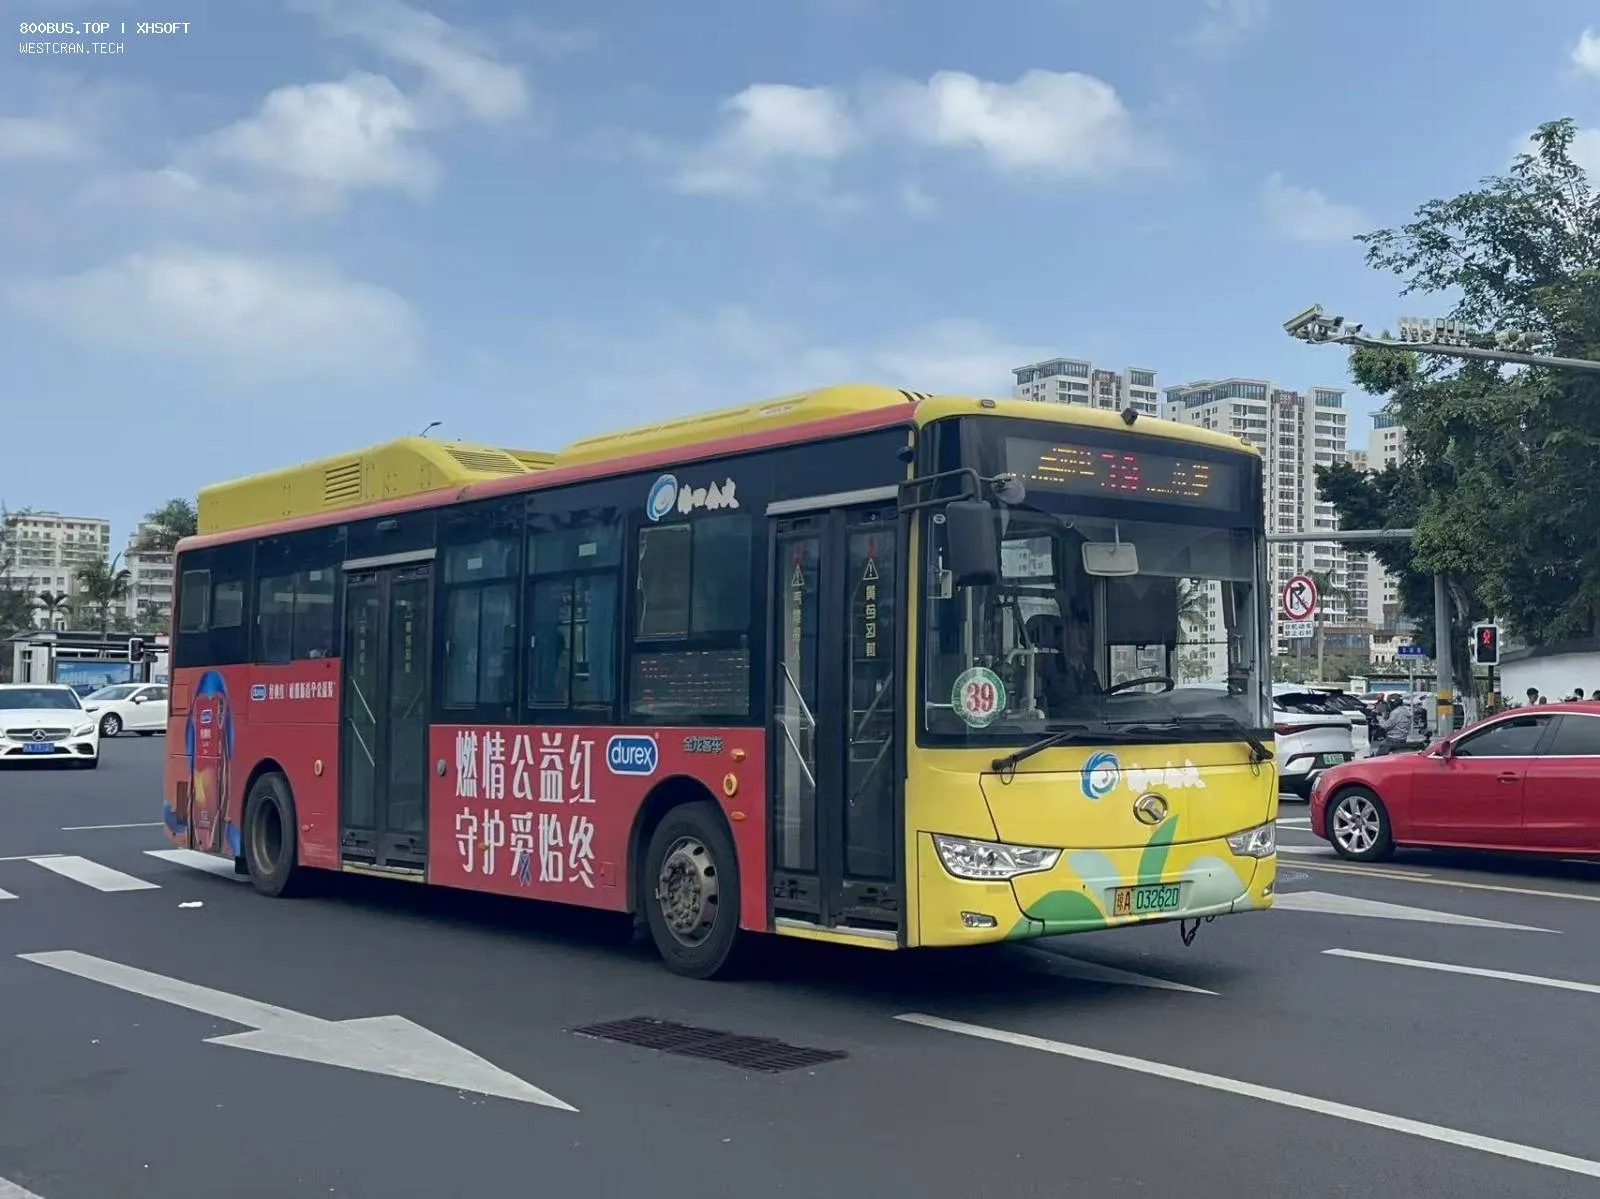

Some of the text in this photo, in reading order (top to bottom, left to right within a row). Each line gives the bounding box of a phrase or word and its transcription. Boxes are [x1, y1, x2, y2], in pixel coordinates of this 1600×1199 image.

[967, 682, 994, 712] 39
[455, 730, 596, 803] 燃情公益红
[611, 740, 653, 769] durex
[455, 807, 595, 888] 守护爱始终
[1136, 887, 1179, 909] 03262D
